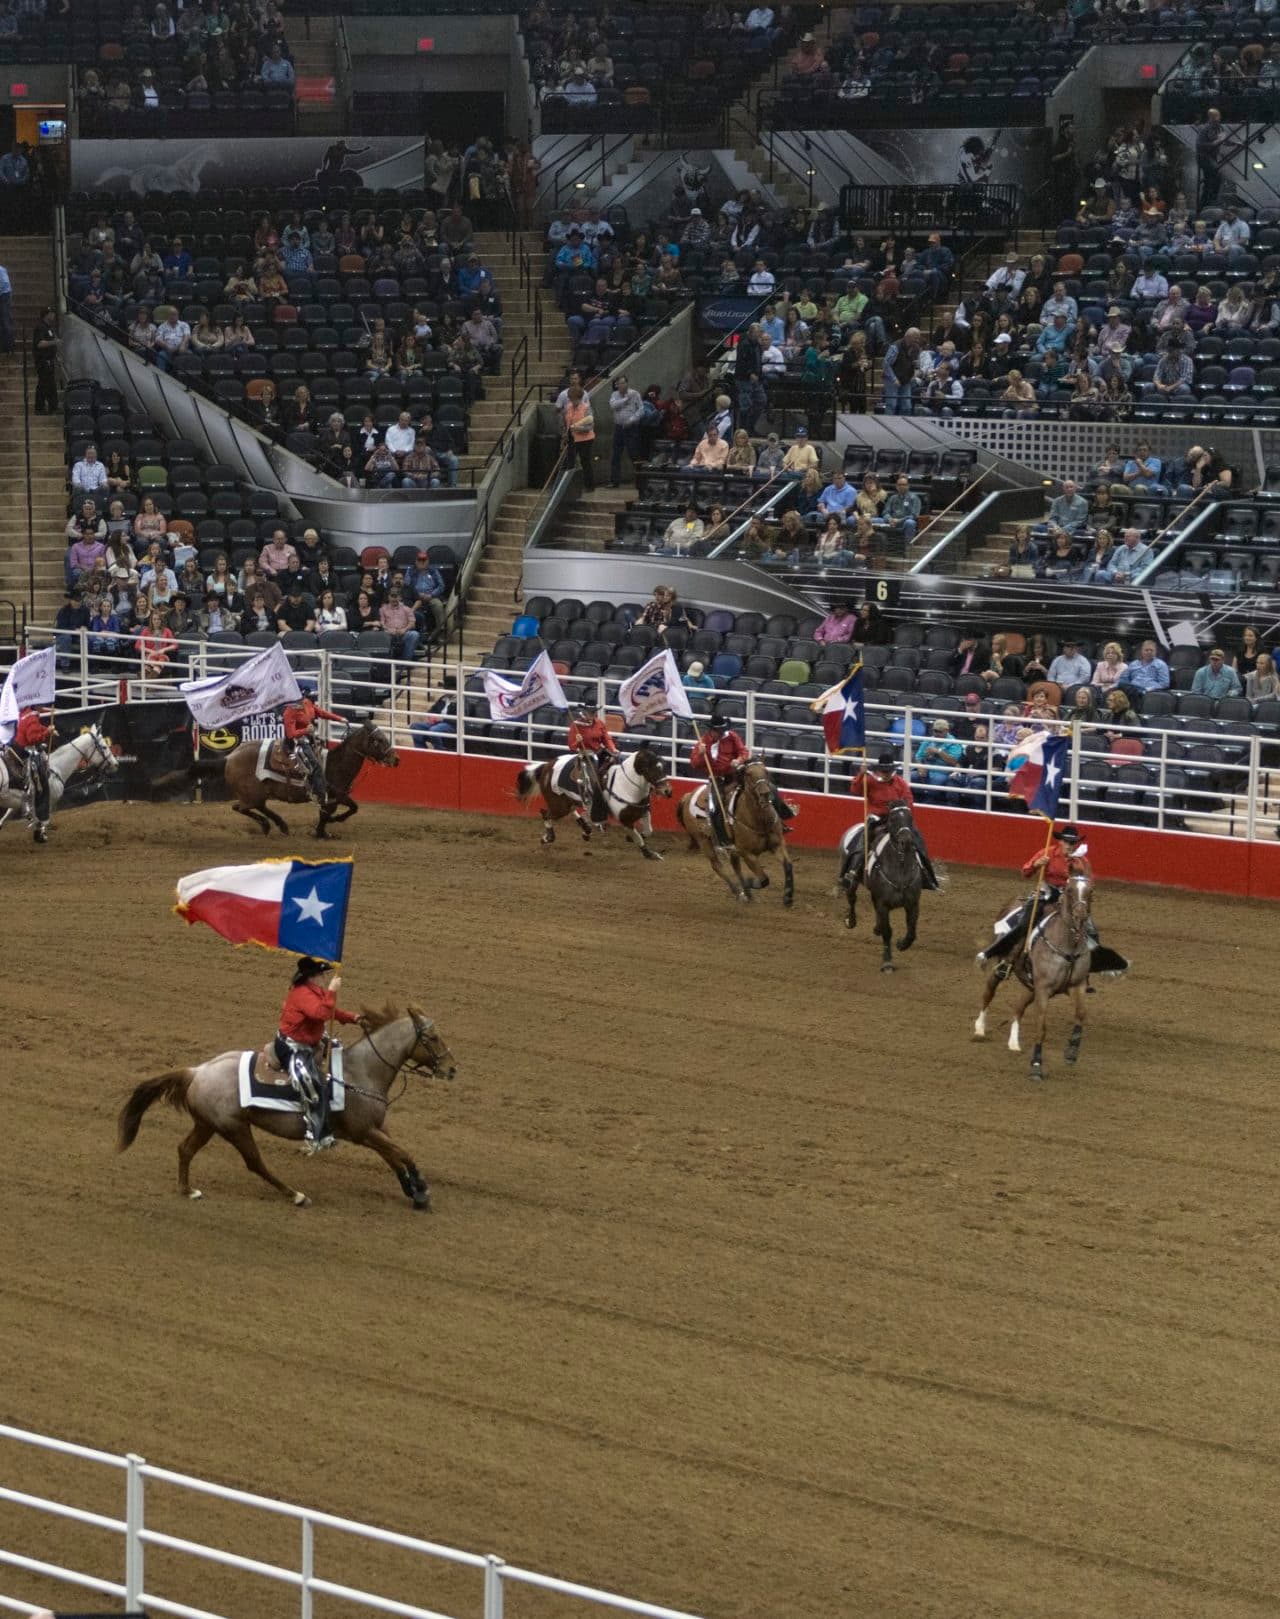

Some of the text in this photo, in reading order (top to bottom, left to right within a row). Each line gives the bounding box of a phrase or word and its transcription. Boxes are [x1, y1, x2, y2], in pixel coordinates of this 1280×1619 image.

[877, 581, 888, 600] 6
[250, 713, 276, 725] LET'S
[241, 724, 285, 742] RODEO
